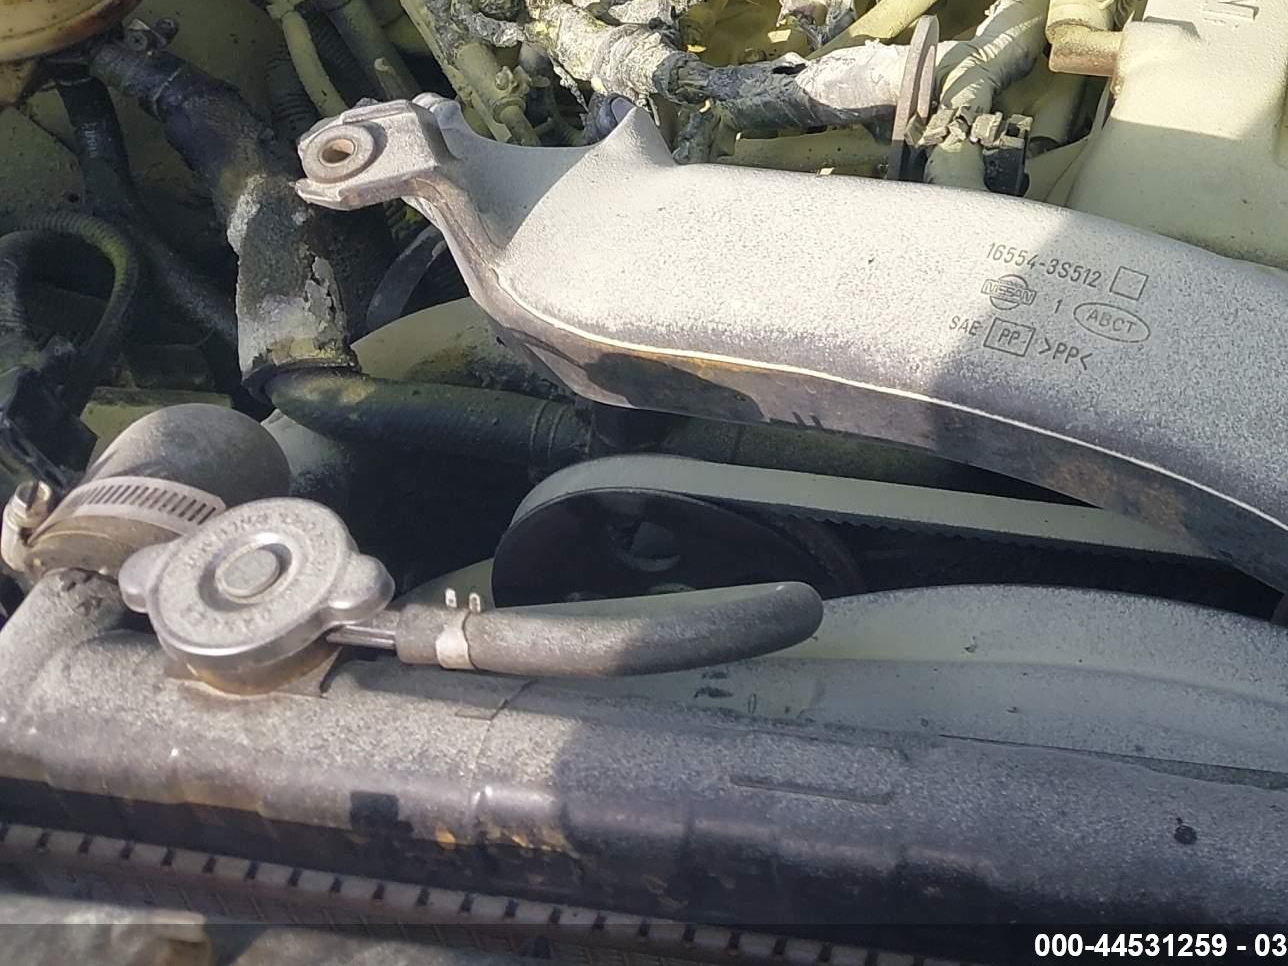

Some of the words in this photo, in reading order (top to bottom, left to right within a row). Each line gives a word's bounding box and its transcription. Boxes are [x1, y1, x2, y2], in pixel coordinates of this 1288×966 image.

[986, 243, 1102, 288] 16554-3S512
[949, 315, 981, 336] SAE
[1086, 309, 1136, 334] ABCT
